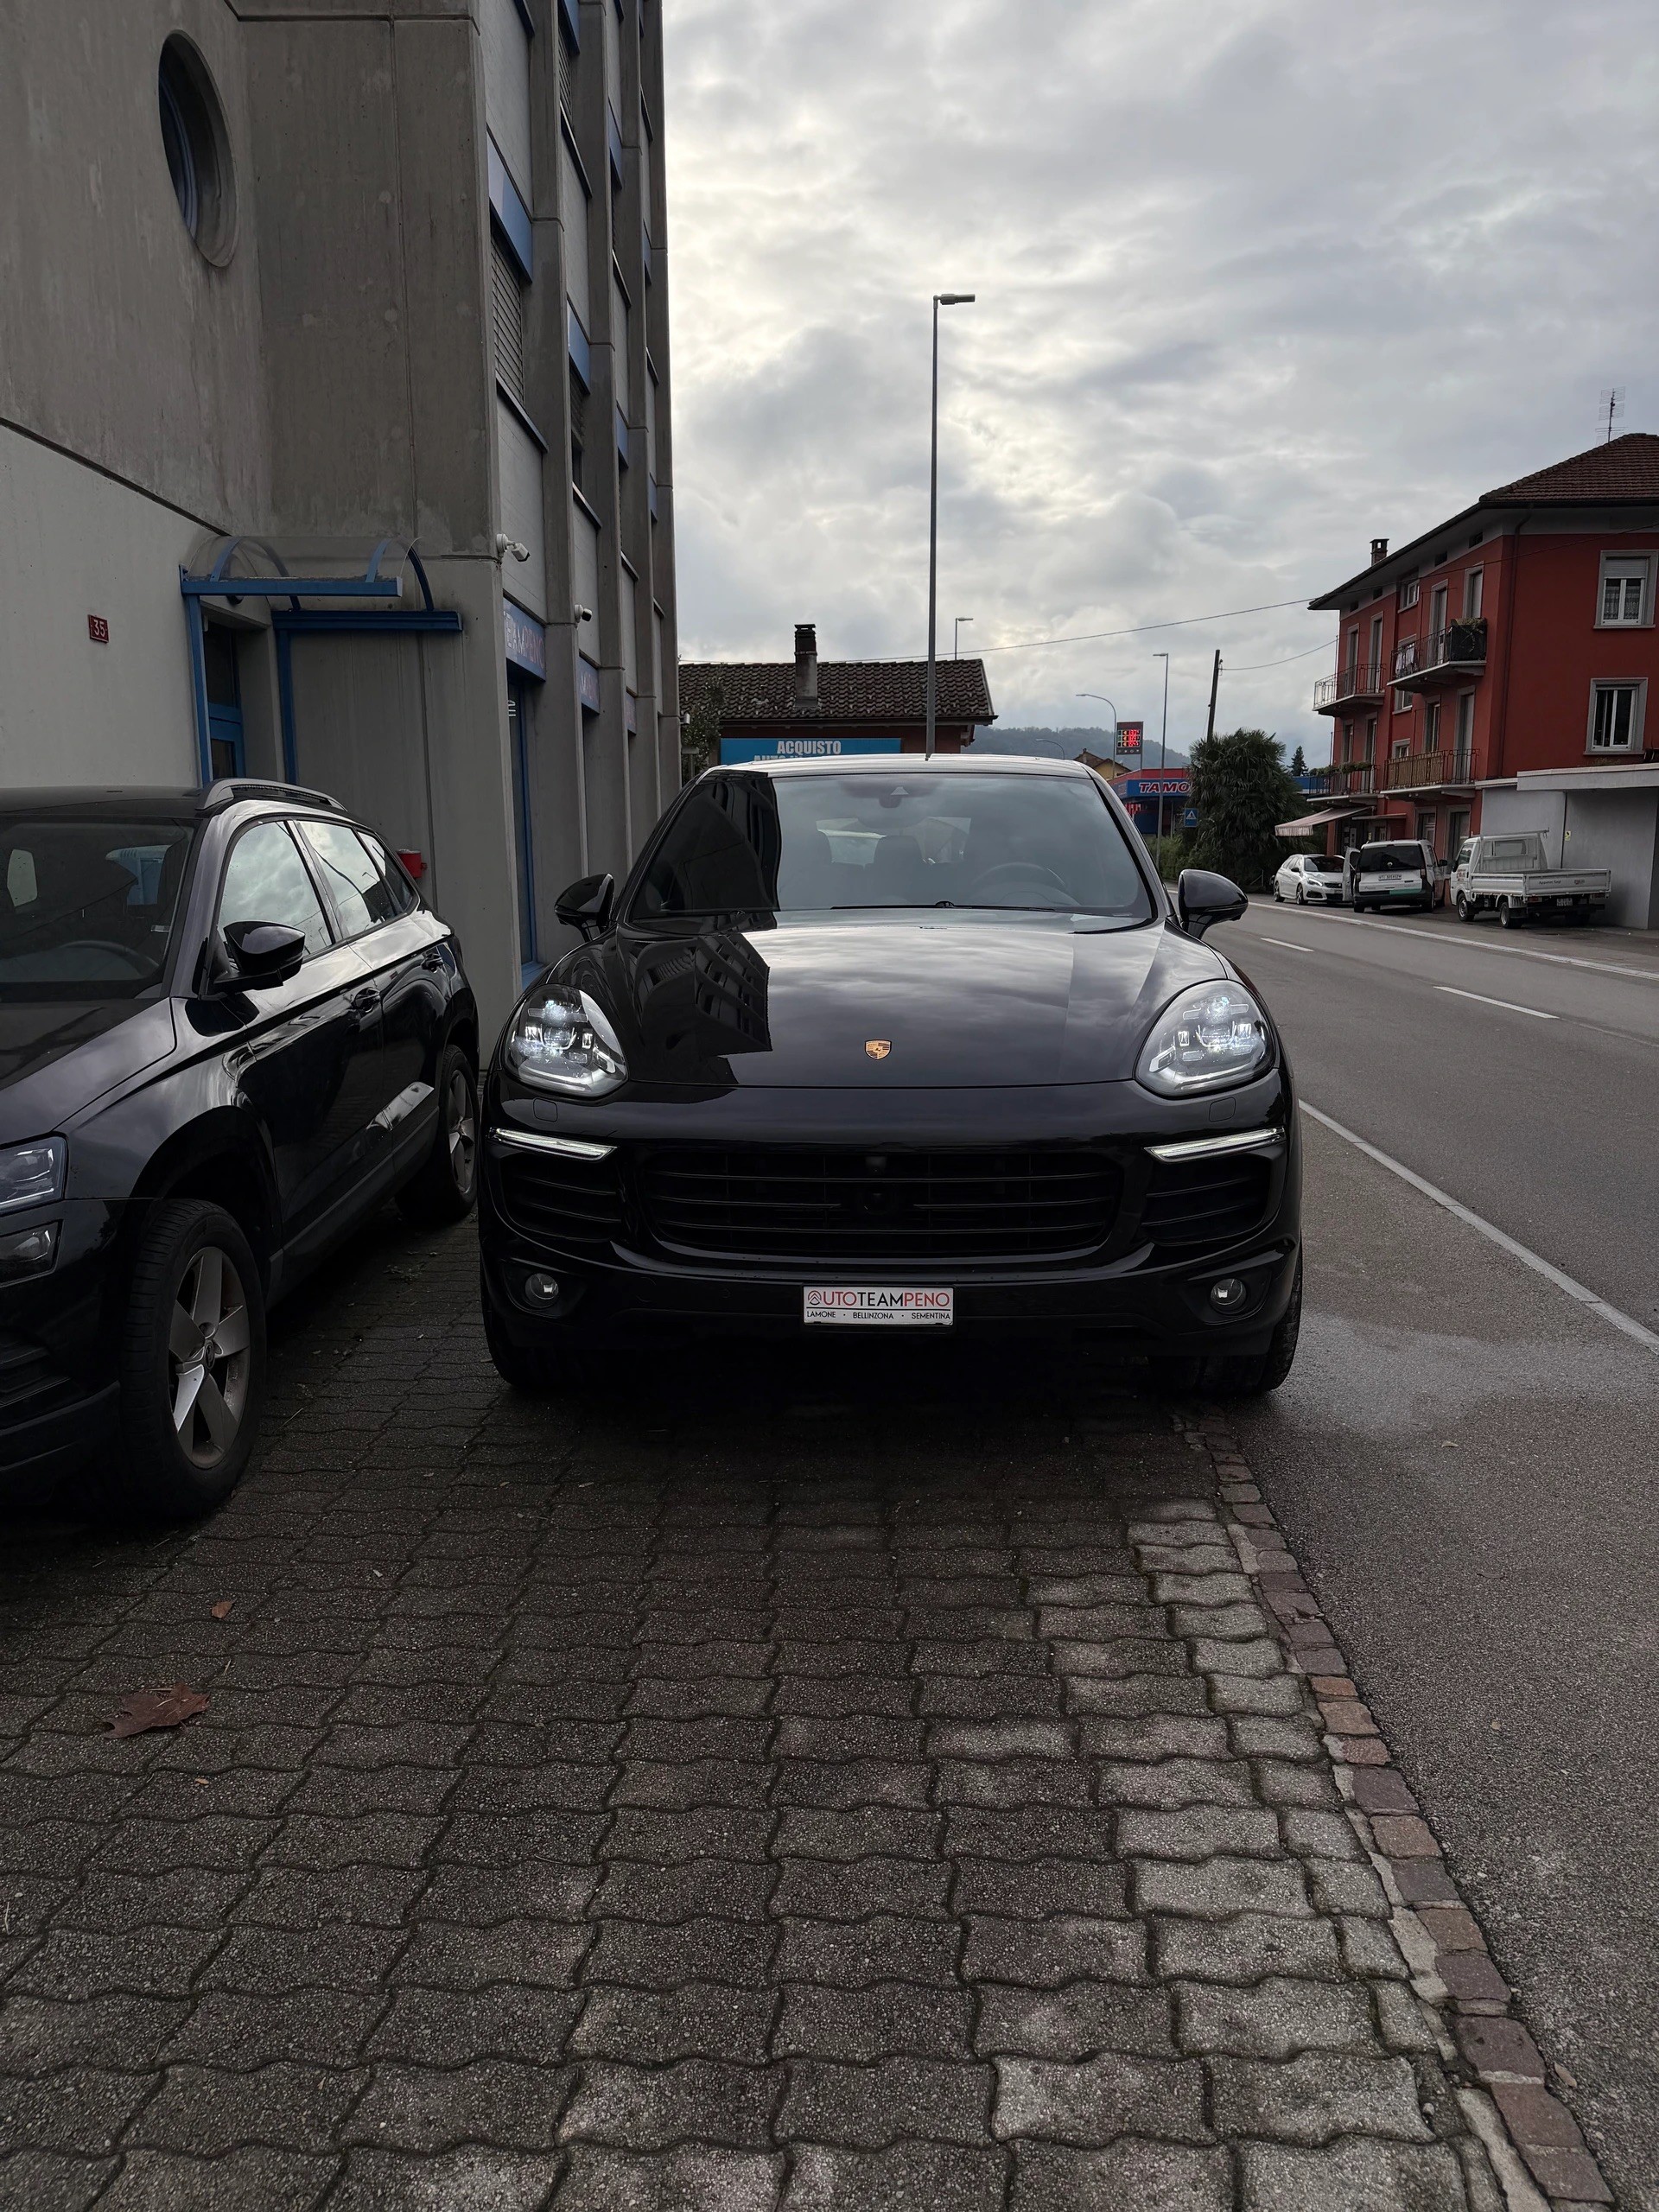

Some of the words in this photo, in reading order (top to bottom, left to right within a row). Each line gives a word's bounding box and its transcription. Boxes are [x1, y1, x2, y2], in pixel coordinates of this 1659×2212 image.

[93, 619, 105, 638] 35
[777, 741, 842, 755] ACQUISTO
[806, 1310, 836, 1319] LAMONE
[911, 1312, 951, 1320] SEMENTINA
